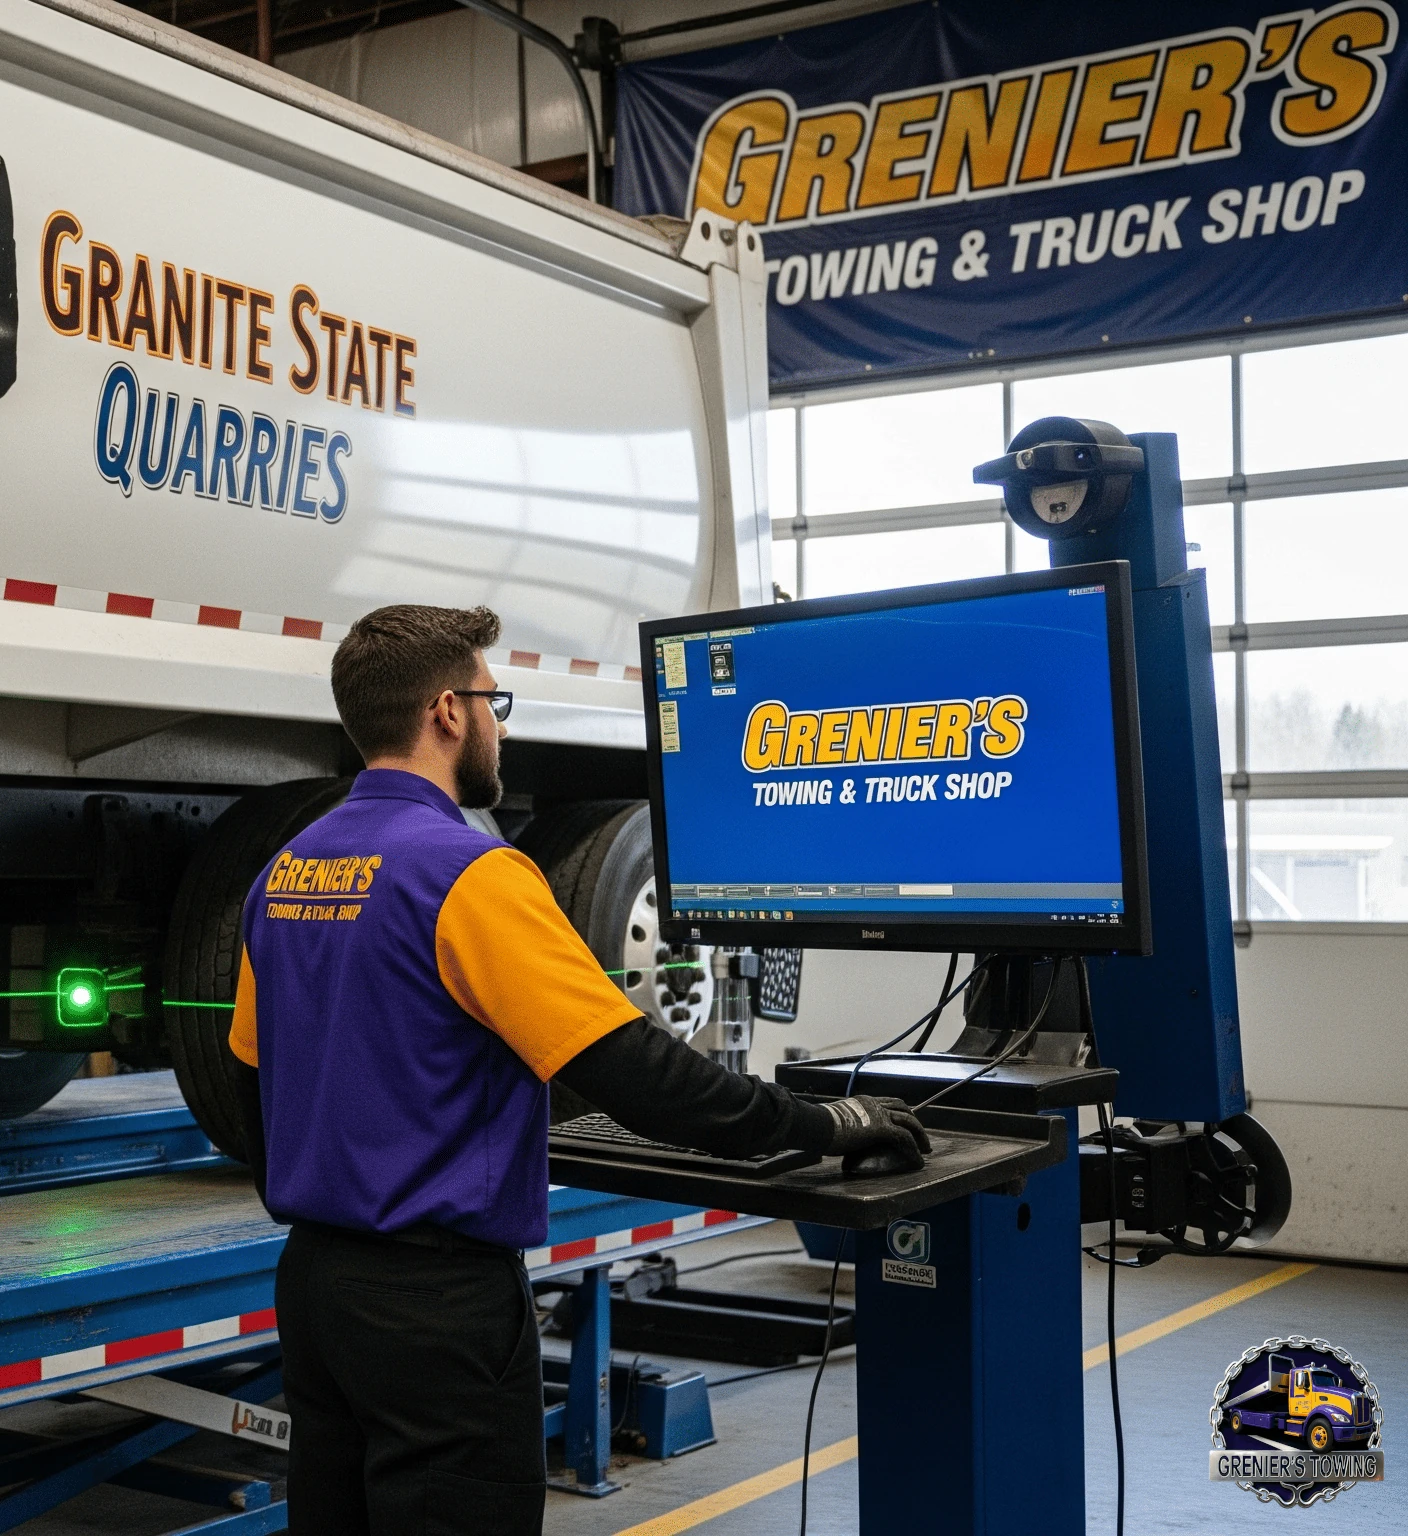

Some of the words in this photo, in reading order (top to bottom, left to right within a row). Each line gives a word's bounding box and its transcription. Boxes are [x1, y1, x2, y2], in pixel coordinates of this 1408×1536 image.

[687, 0, 1399, 233] GRENIER'S
[952, 229, 989, 282] &
[1009, 196, 1192, 274] TRUCK
[1201, 169, 1365, 244] SHOP
[40, 209, 275, 385] GRANITE
[288, 283, 418, 420] STATE
[94, 360, 352, 524] QUARRIES
[741, 694, 1028, 773] GRENIER'S
[752, 778, 832, 806] TOWING
[838, 777, 856, 804] &
[864, 774, 939, 803] TRUCK
[945, 771, 1012, 799] SHOP
